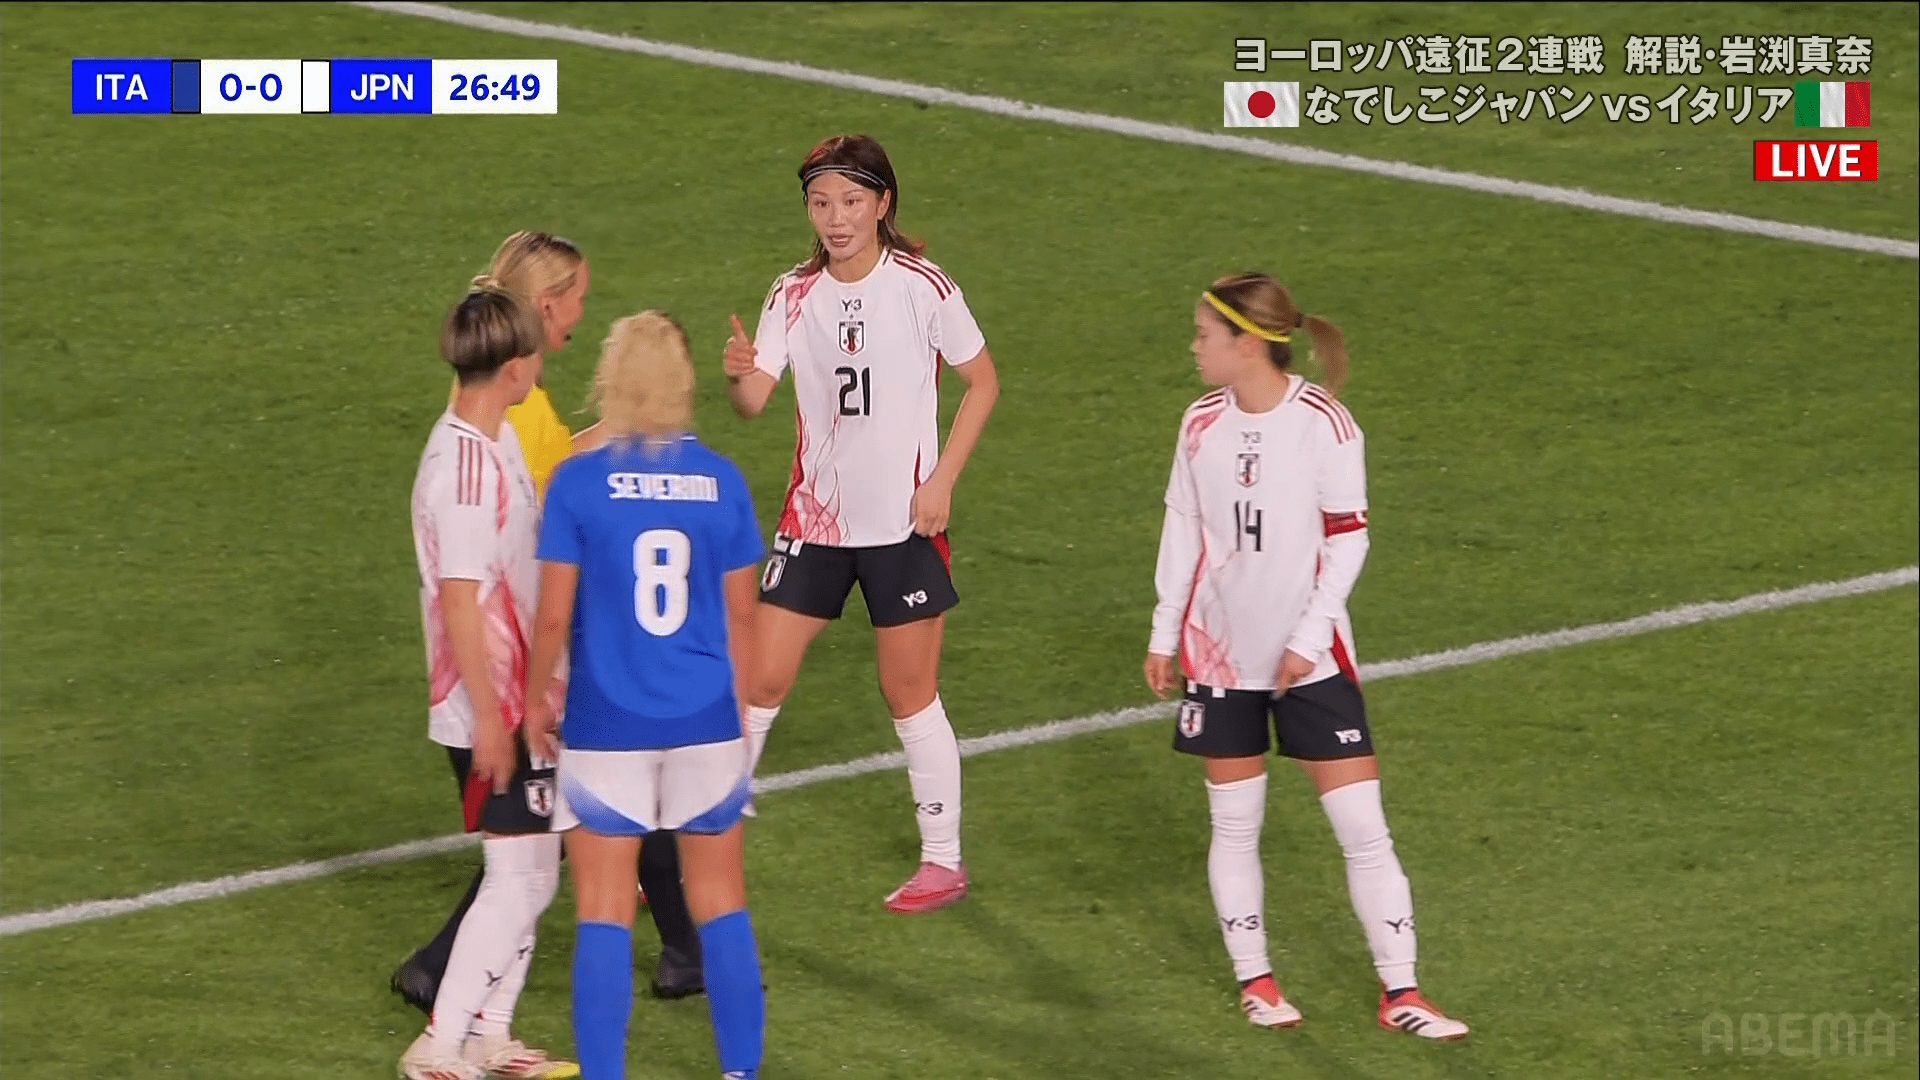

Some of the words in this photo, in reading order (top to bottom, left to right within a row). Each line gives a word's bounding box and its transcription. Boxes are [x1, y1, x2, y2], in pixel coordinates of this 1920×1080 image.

[834, 366, 871, 416] 21
[1234, 500, 1262, 552] 14
[632, 528, 692, 637] 8
